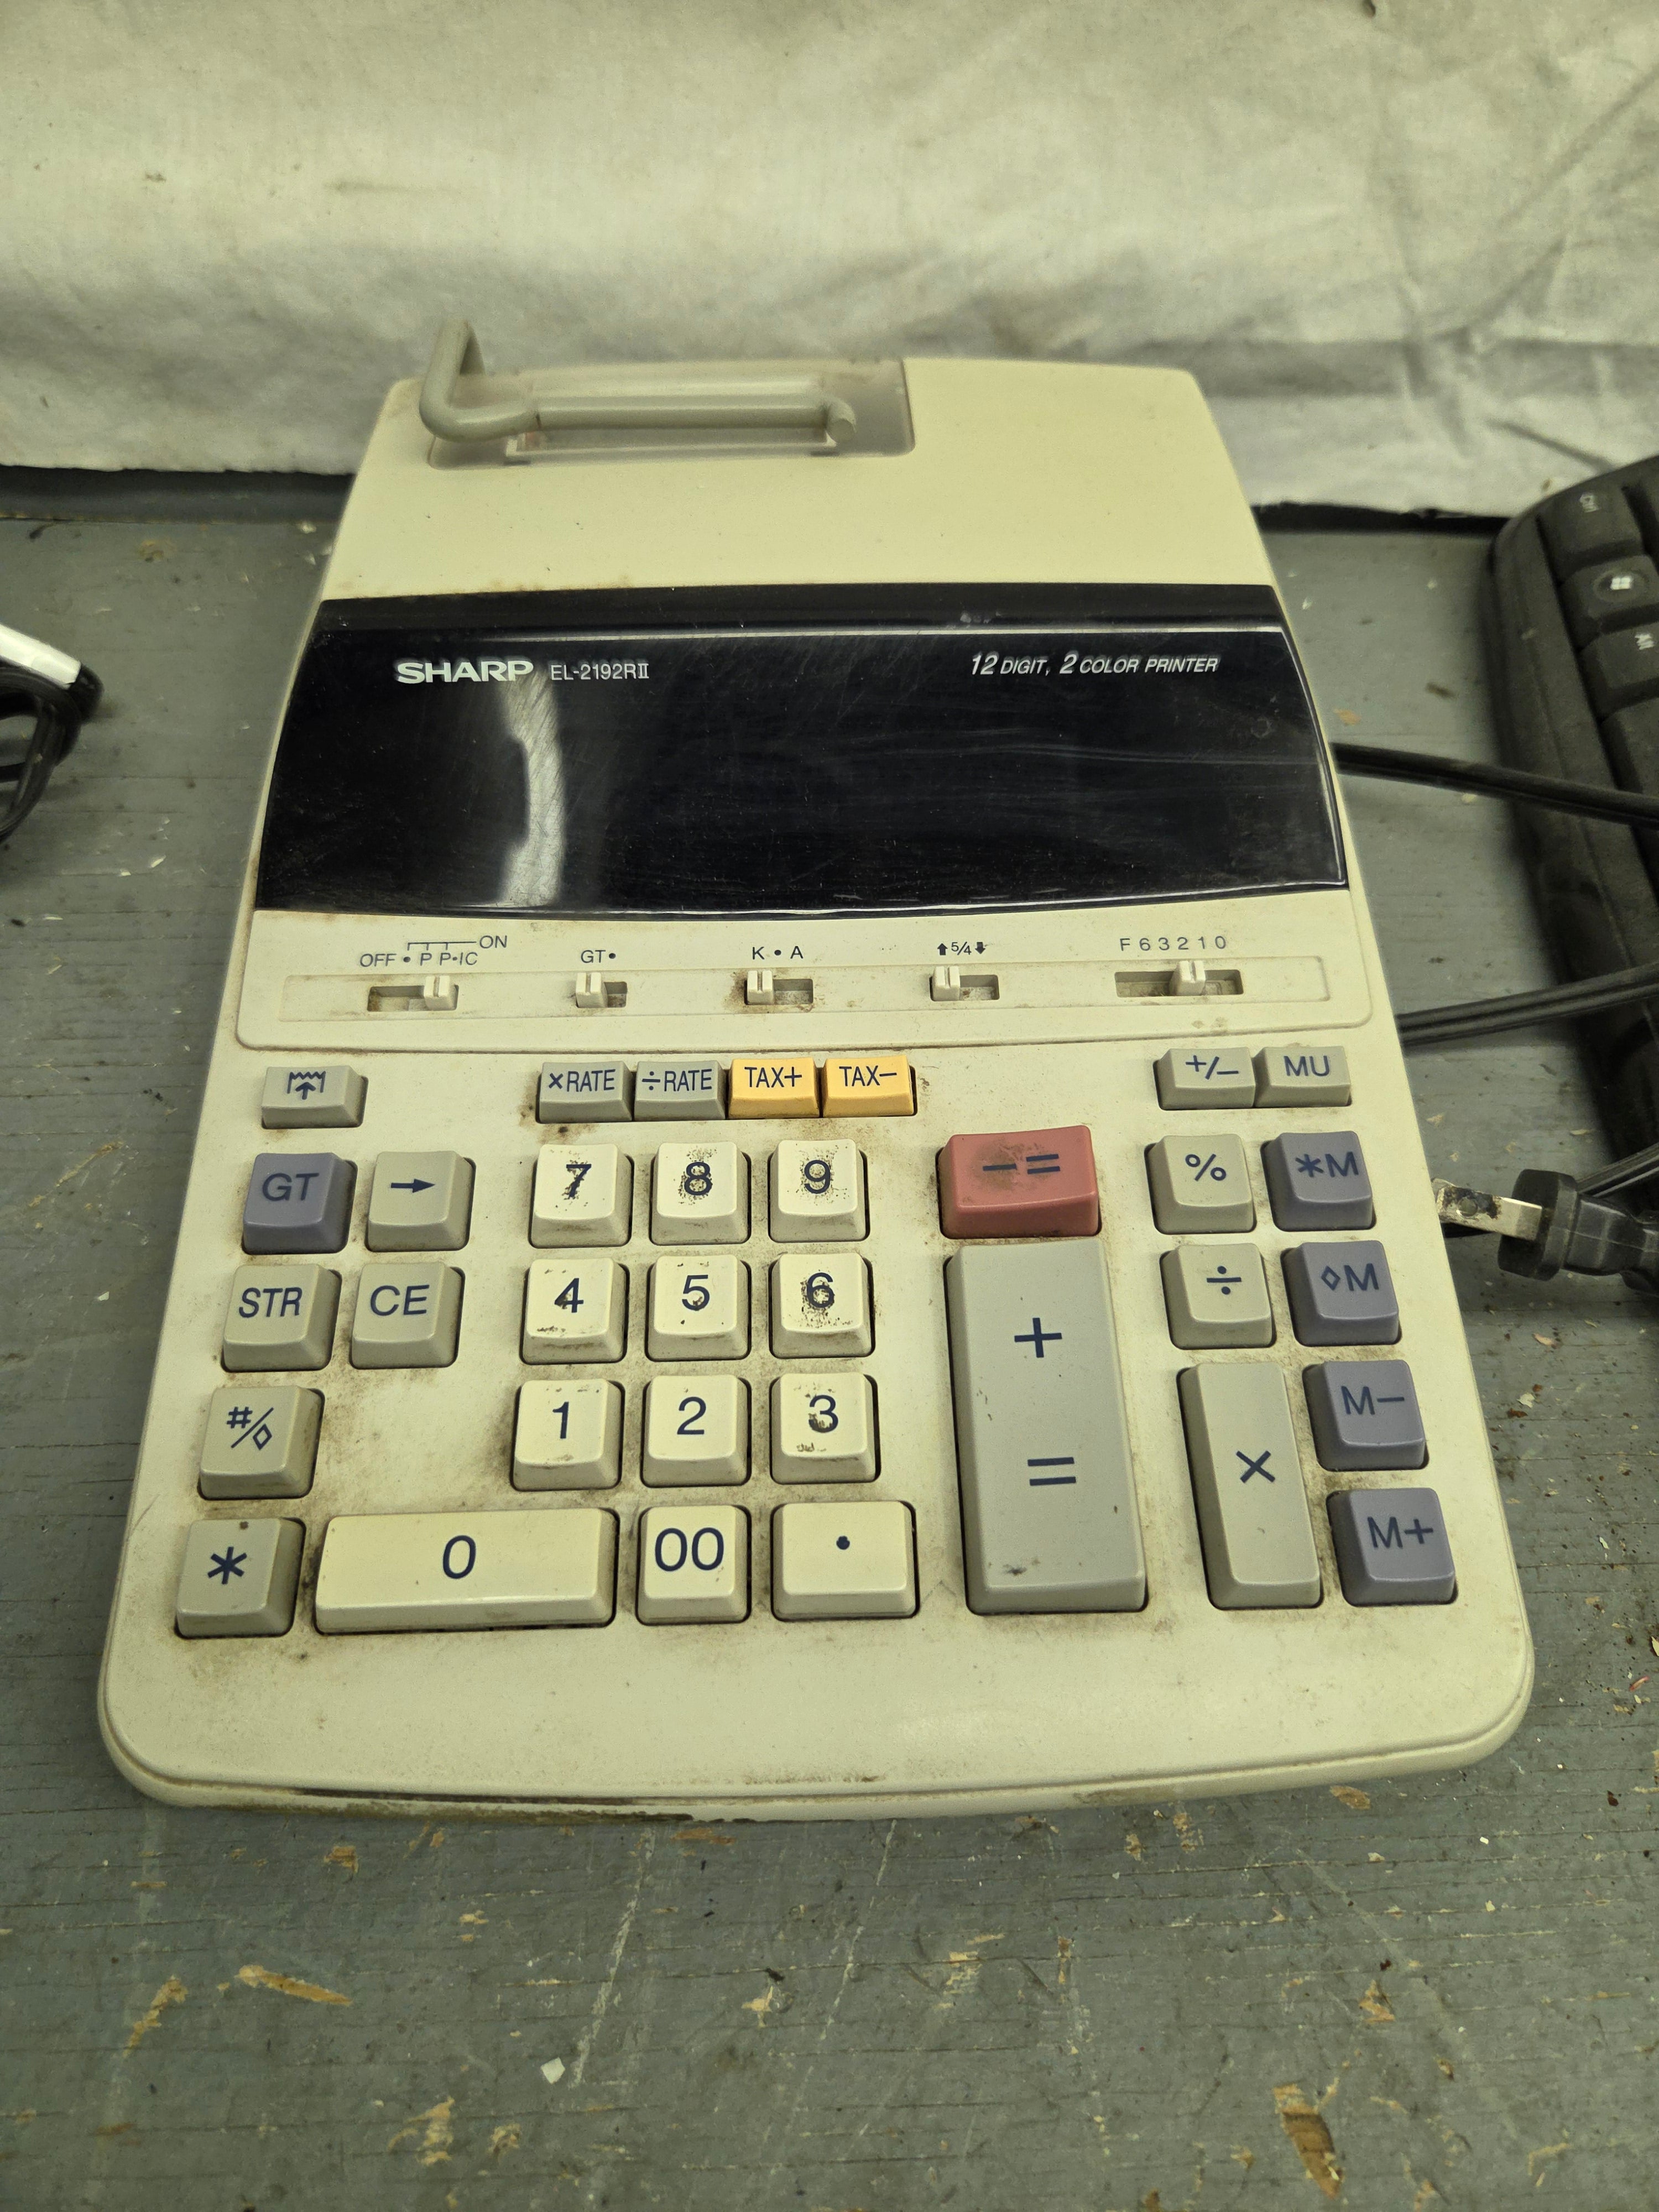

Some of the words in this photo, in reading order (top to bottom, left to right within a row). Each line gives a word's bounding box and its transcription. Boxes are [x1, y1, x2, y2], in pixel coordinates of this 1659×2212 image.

[397, 661, 534, 684] SHARP
[972, 655, 998, 675] 12
[1000, 659, 1050, 676] DIGIT,
[1060, 655, 1078, 674] 2
[1079, 658, 1138, 674] COLOR
[1145, 658, 1218, 673] PRINTER
[479, 935, 508, 949] ON
[359, 953, 397, 967] OFF
[420, 952, 432, 966] P
[744, 1066, 802, 1088] TAX+
[1284, 1055, 1330, 1077] MU
[262, 1172, 320, 1202] GT
[566, 1164, 592, 1198] 7
[684, 1162, 713, 1196] 8
[804, 1160, 831, 1194] 9
[238, 1287, 302, 1318] STR
[370, 1284, 430, 1316] CE
[554, 1277, 583, 1313] 4
[681, 1275, 710, 1311] 5
[806, 1272, 835, 1308] 6
[552, 1401, 569, 1439] 1
[677, 1396, 707, 1435] 2
[808, 1395, 839, 1433] 3
[1367, 1516, 1434, 1548] M+
[442, 1535, 476, 1579] 0
[655, 1527, 724, 1572] 00
